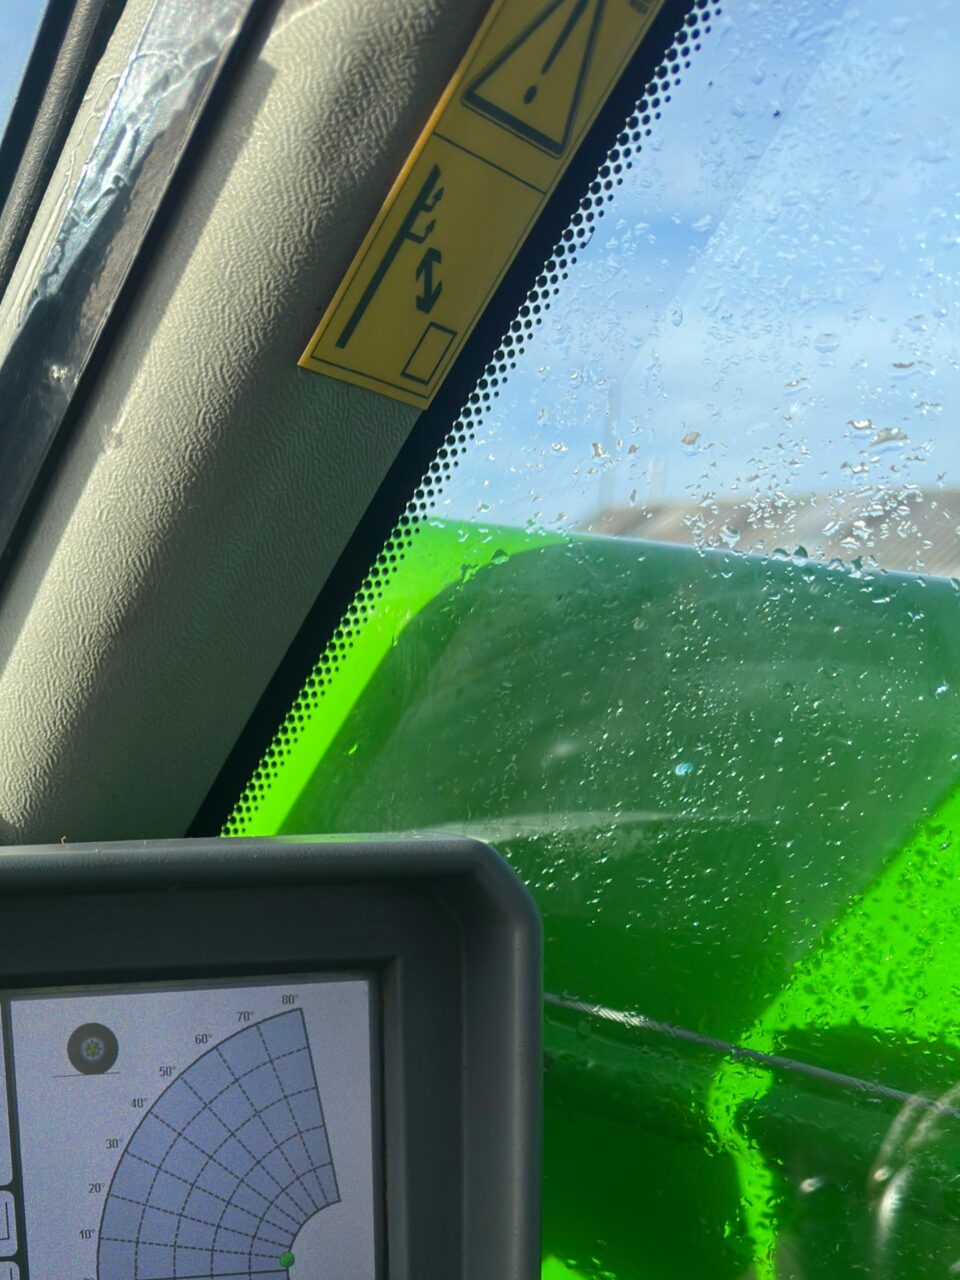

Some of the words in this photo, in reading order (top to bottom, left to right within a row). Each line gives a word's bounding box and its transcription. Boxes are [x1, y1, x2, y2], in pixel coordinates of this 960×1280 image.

[282, 994, 299, 1005] 80°
[238, 1011, 254, 1022] 70°
[195, 1033, 212, 1045] 60°
[159, 1066, 176, 1077] 50°
[131, 1097, 148, 1109] 40°
[106, 1138, 123, 1149] 30°
[89, 1182, 105, 1194] 20°
[80, 1229, 96, 1240] 10°
